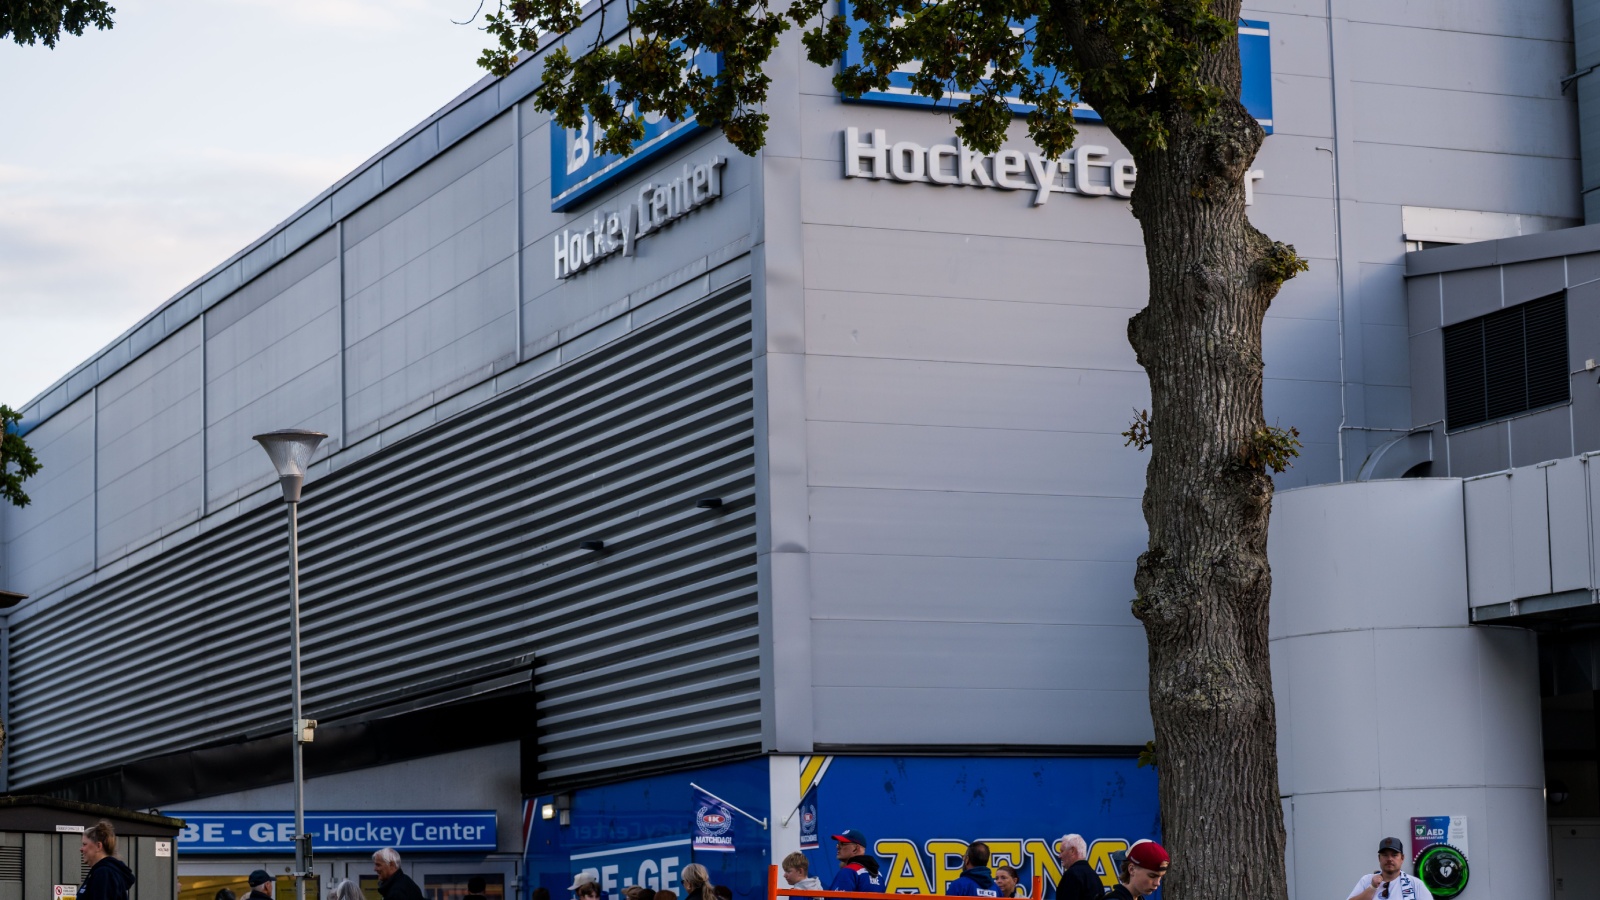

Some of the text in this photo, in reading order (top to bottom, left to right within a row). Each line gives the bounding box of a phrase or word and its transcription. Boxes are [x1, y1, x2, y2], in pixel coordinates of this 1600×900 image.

[844, 127, 1264, 206] Hockey Cer
[554, 155, 727, 280] Hockey Center
[324, 822, 405, 846] Hockey
[411, 821, 486, 841] Center
[695, 836, 732, 845] MATCHDAG!
